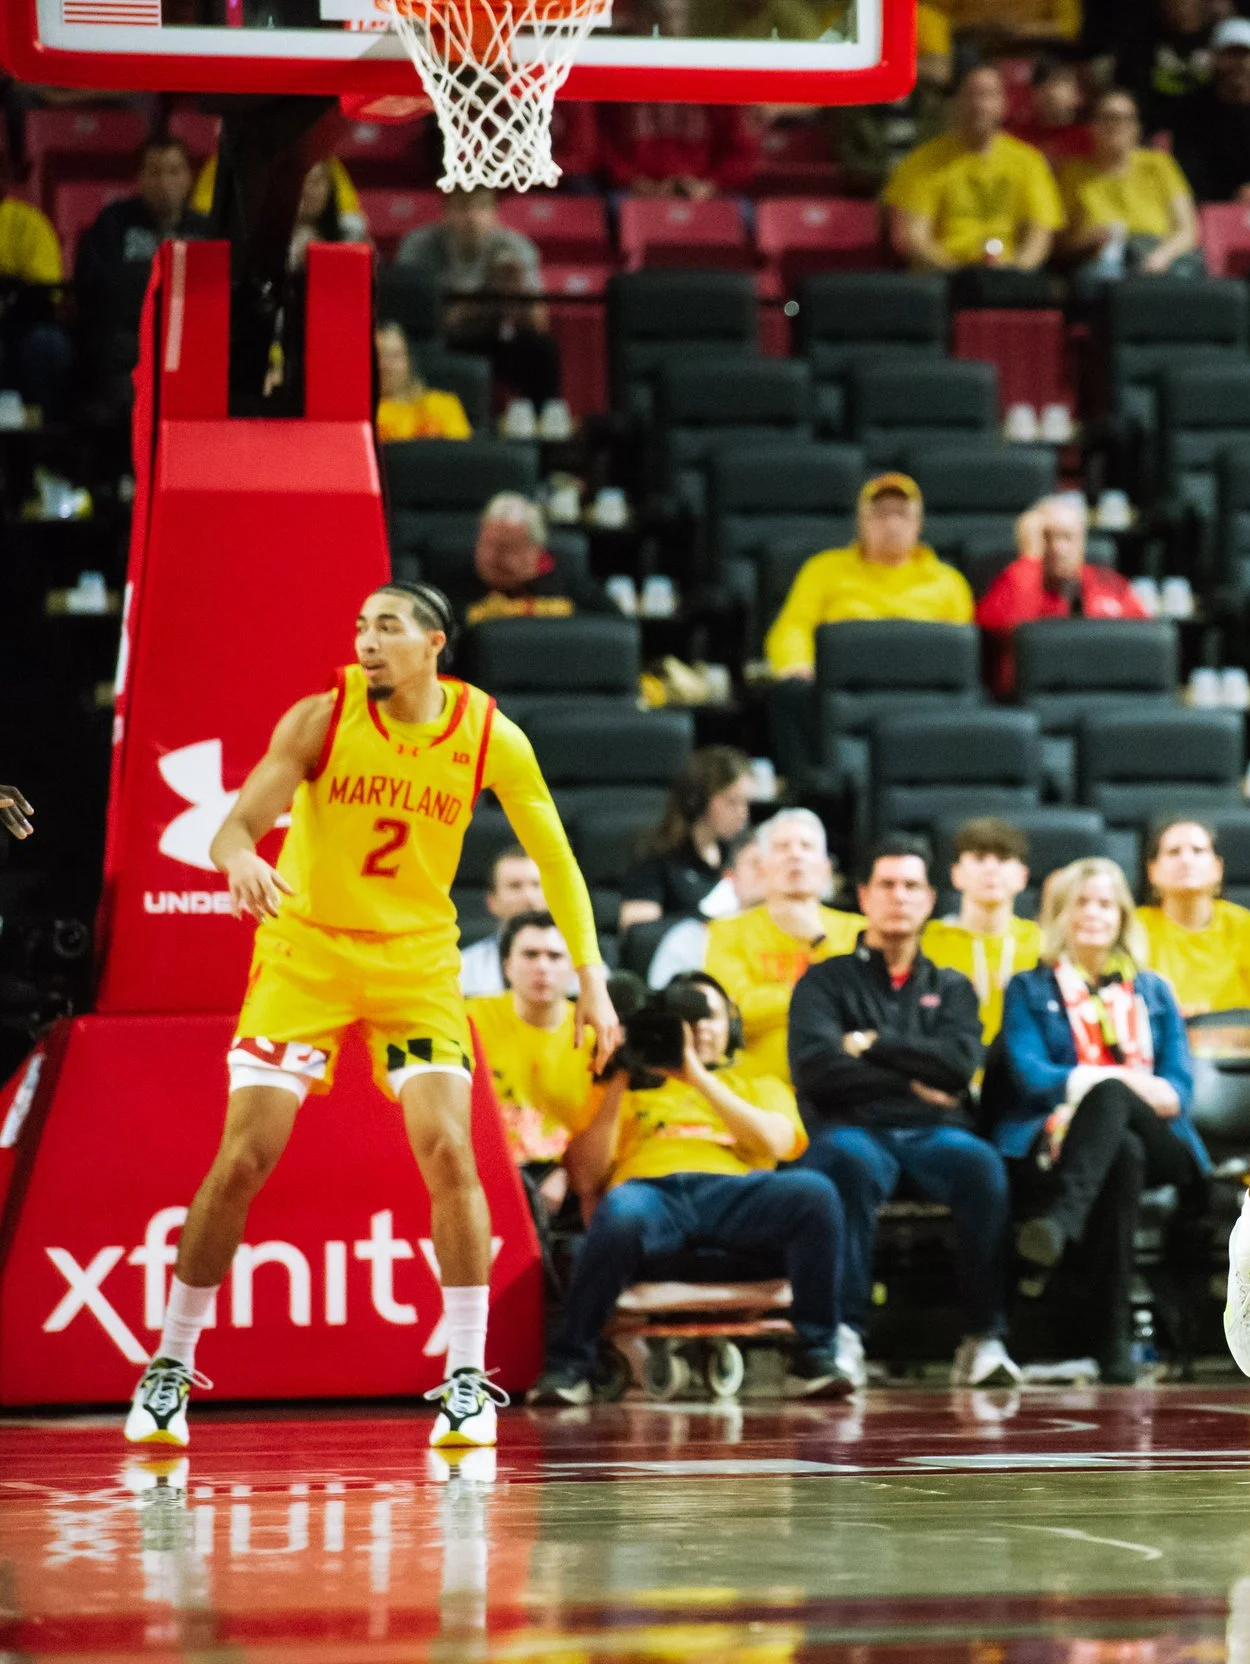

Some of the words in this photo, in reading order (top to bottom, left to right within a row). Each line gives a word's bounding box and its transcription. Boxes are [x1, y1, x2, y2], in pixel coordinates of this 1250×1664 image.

[328, 775, 462, 826] MARYLAND
[360, 817, 411, 879] 2
[144, 891, 240, 915] UNDE
[42, 1206, 504, 1365] xfnit
